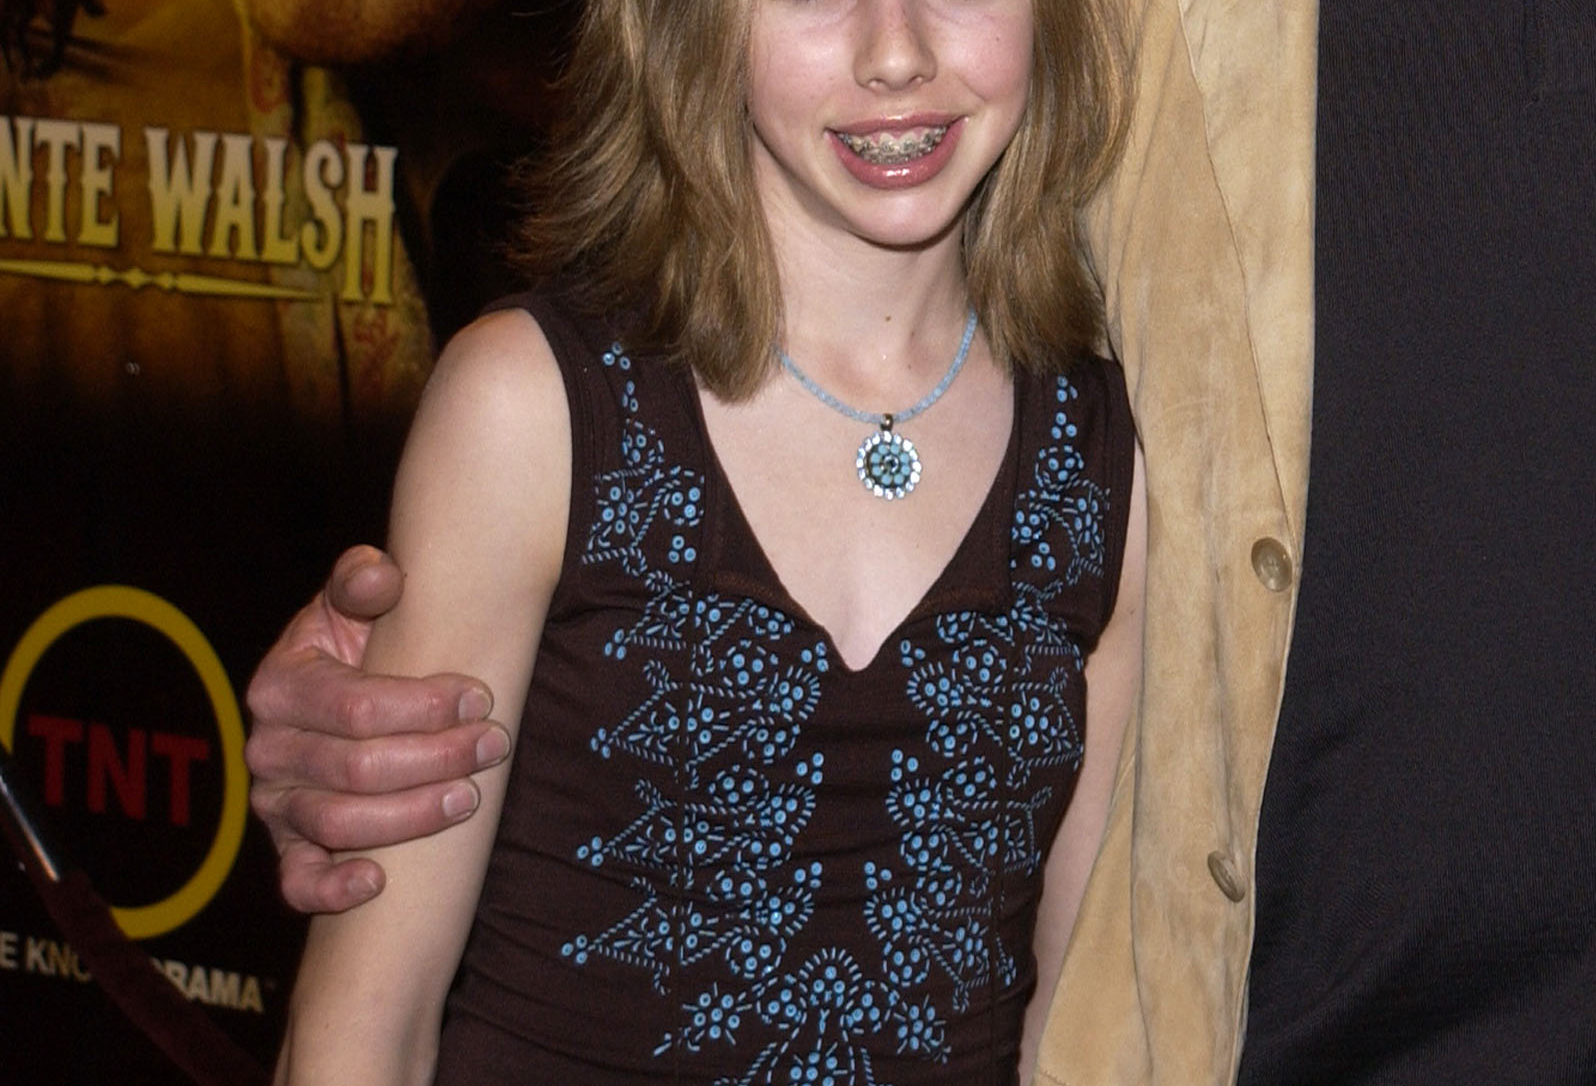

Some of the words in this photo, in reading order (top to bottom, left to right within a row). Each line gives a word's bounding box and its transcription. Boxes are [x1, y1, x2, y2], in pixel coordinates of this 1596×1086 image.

[144, 126, 399, 305] WALSH
[27, 714, 210, 826] TNT
[150, 956, 263, 1013] RAMA
